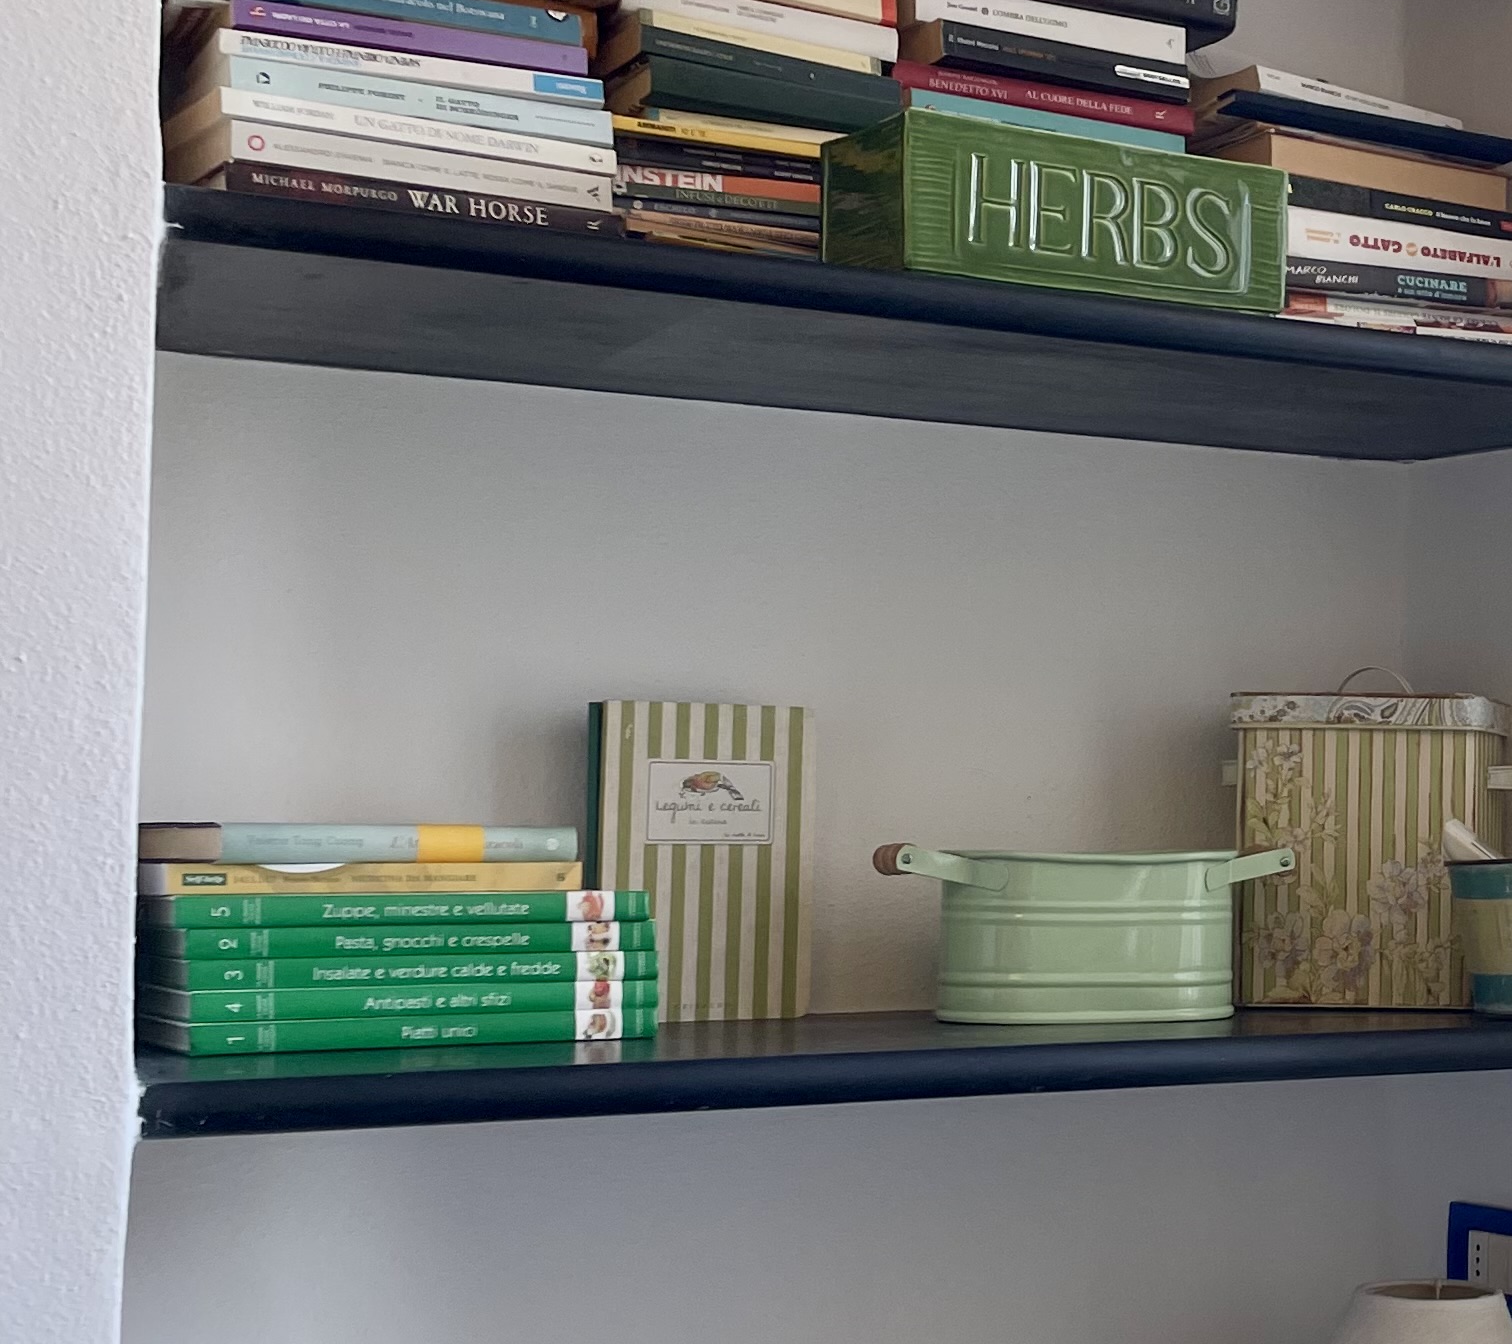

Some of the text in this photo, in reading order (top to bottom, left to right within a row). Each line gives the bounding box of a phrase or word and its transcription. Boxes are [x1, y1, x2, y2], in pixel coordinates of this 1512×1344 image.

[929, 78, 989, 97] BENEDETTO
[990, 86, 1008, 100] XVI
[1025, 89, 1134, 115] AL CUORE DELLA FEDE
[252, 173, 398, 202] MICHAEL MORPURGO
[617, 165, 723, 192] INSTEIN
[407, 190, 549, 227] WAR HORSE
[967, 150, 1234, 280] HERBS
[1348, 233, 1403, 254] GATTO
[1420, 245, 1502, 269] L'ALFABETO
[1285, 265, 1327, 276] MARCO
[1315, 274, 1359, 285] BIANCHI
[1396, 274, 1468, 293] CUCINARE
[655, 800, 702, 823] Legumi
[708, 803, 715, 812] e
[719, 798, 762, 812] cereali
[210, 905, 231, 917] 5
[322, 901, 530, 920] Zuppe, minestre e vellutate
[218, 938, 239, 950] 2
[335, 931, 530, 953] Pasta, gnocchi e crespelle
[224, 969, 245, 981] 3
[312, 961, 562, 981] Insalate e verdure calde e fredde
[225, 1002, 244, 1013] 4
[363, 991, 512, 1011] Antipasti e altri sfizi
[226, 1035, 246, 1044] 1
[401, 1023, 479, 1040] Piatti unici
